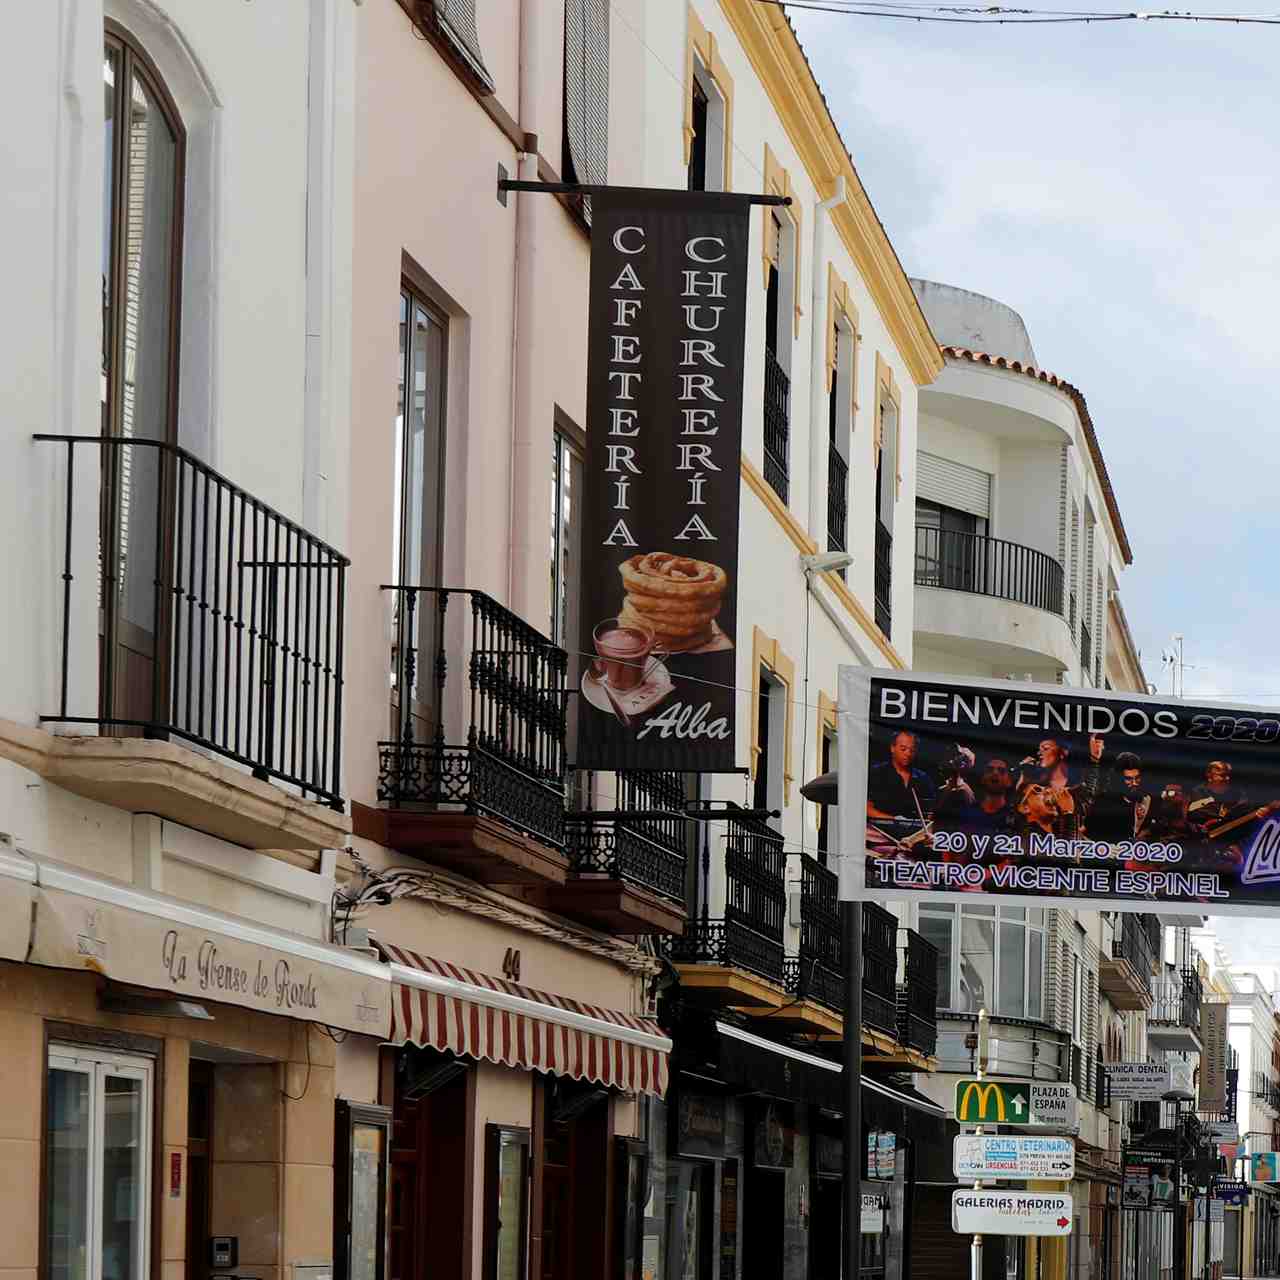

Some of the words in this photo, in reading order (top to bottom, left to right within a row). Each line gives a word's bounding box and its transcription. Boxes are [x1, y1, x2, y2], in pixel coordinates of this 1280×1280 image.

[603, 225, 646, 547] CAFETERÍA
[673, 236, 727, 542] CHURRERÍA
[636, 701, 731, 740] Alba
[880, 687, 1180, 738] BIENVENIDOS
[1185, 715, 1280, 743] 2020
[931, 831, 967, 853] 20
[971, 835, 989, 859] y
[992, 834, 1023, 855] 21
[1029, 833, 1109, 860] Marzo
[1115, 842, 1183, 863] 2020
[874, 858, 984, 886] TEATRO
[990, 865, 1110, 892] VICENTE
[1115, 870, 1230, 898] ESPINEL
[162, 930, 187, 984] La
[254, 960, 270, 998] de
[502, 947, 521, 981] 44
[1032, 1086, 1057, 1097] PLAZA
[1059, 1087, 1070, 1097] DE
[1034, 1097, 1066, 1110] ESPAÑA
[985, 1139, 1016, 1150] CENTRO
[1020, 1140, 1072, 1151] VETERINARIO
[956, 1197, 1014, 1208] GALERIAS
[1017, 1199, 1065, 1210] MADRID
